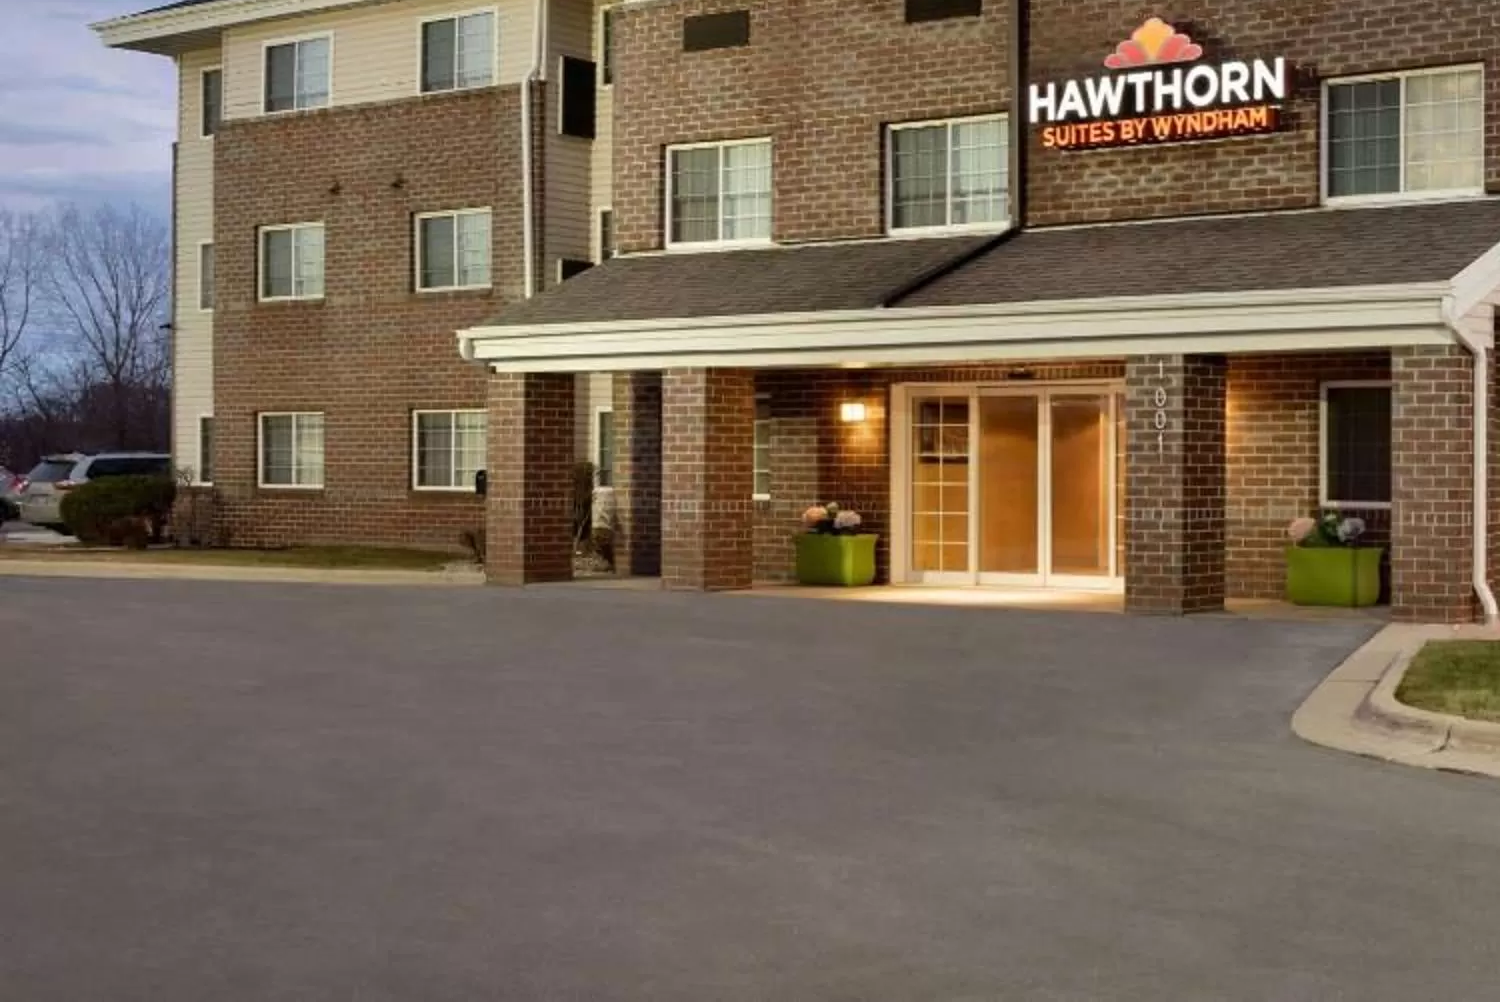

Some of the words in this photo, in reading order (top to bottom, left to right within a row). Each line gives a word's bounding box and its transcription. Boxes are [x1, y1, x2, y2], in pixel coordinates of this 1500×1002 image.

[1029, 57, 1286, 123] HAWTHORN
[1043, 122, 1115, 147] SUITES
[1120, 118, 1147, 140] BY
[1151, 106, 1268, 137] WYNDHAM
[1155, 359, 1167, 453] 1001
